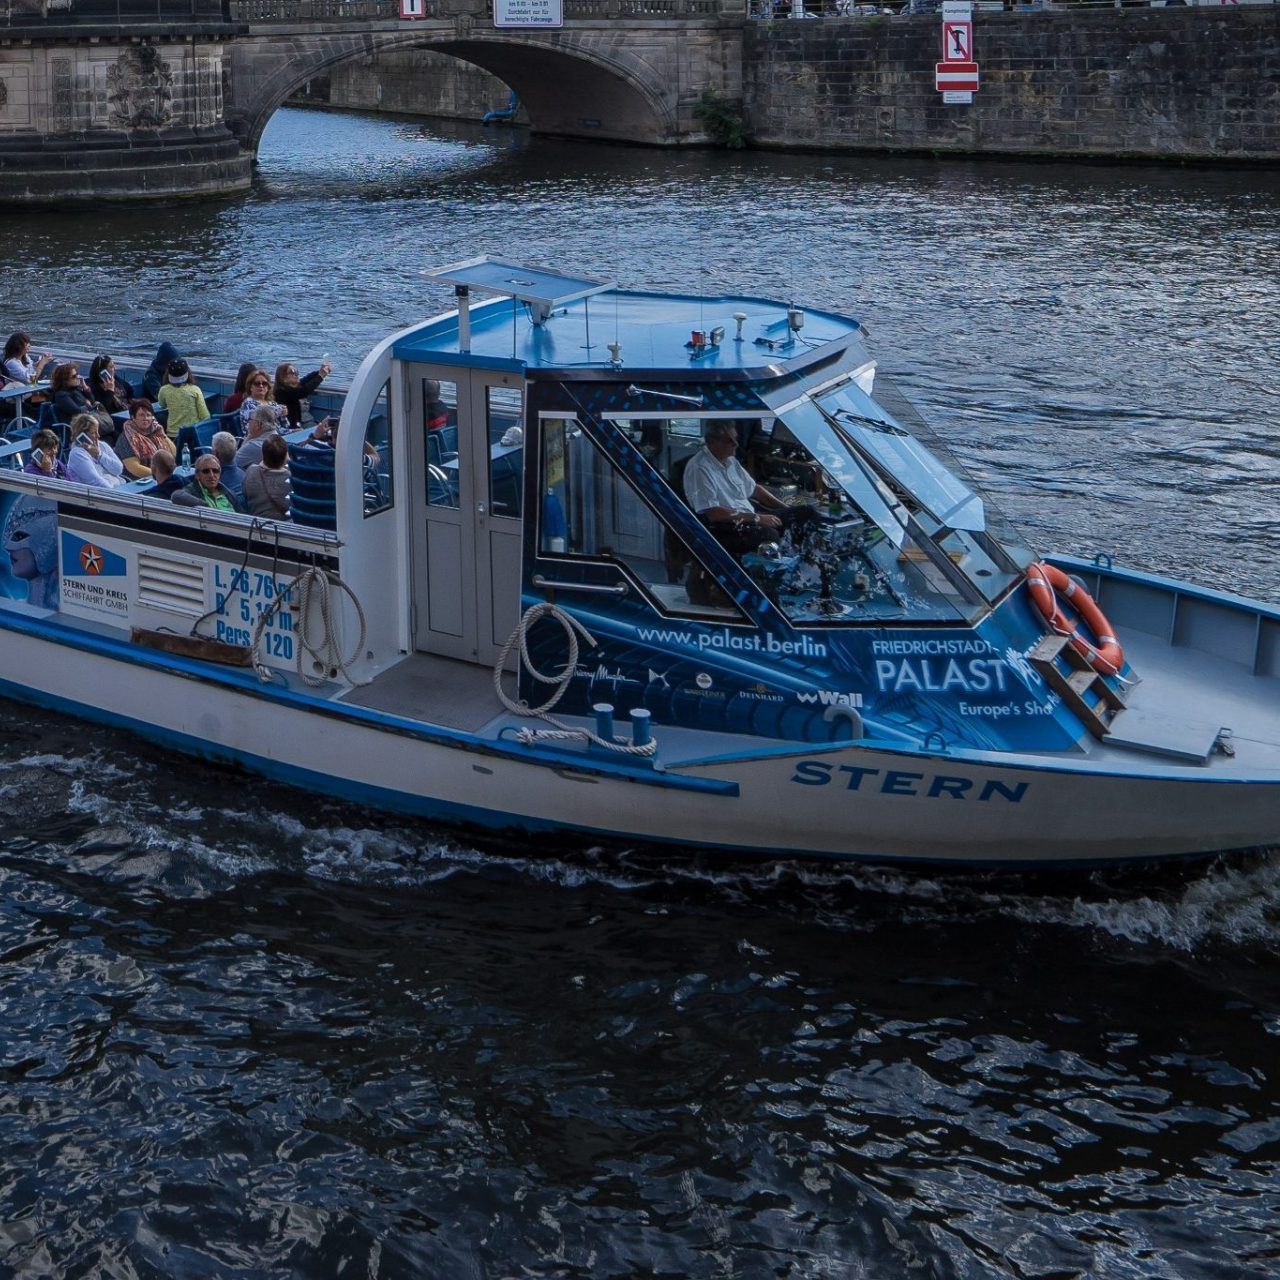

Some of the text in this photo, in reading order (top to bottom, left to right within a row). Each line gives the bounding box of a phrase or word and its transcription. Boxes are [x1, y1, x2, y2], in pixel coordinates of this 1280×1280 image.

[62, 578, 128, 601] STERN UND KREIS
[215, 565, 227, 589] L.
[230, 568, 274, 599] 26,76
[105, 598, 129, 612] GMBH
[279, 611, 293, 632] m
[265, 631, 293, 660] 120
[636, 627, 827, 658] www.palast.berlin
[874, 658, 1009, 692] PALAST
[817, 690, 864, 708] Wall
[959, 701, 1021, 720] Europe's
[789, 759, 1031, 803] STERN
